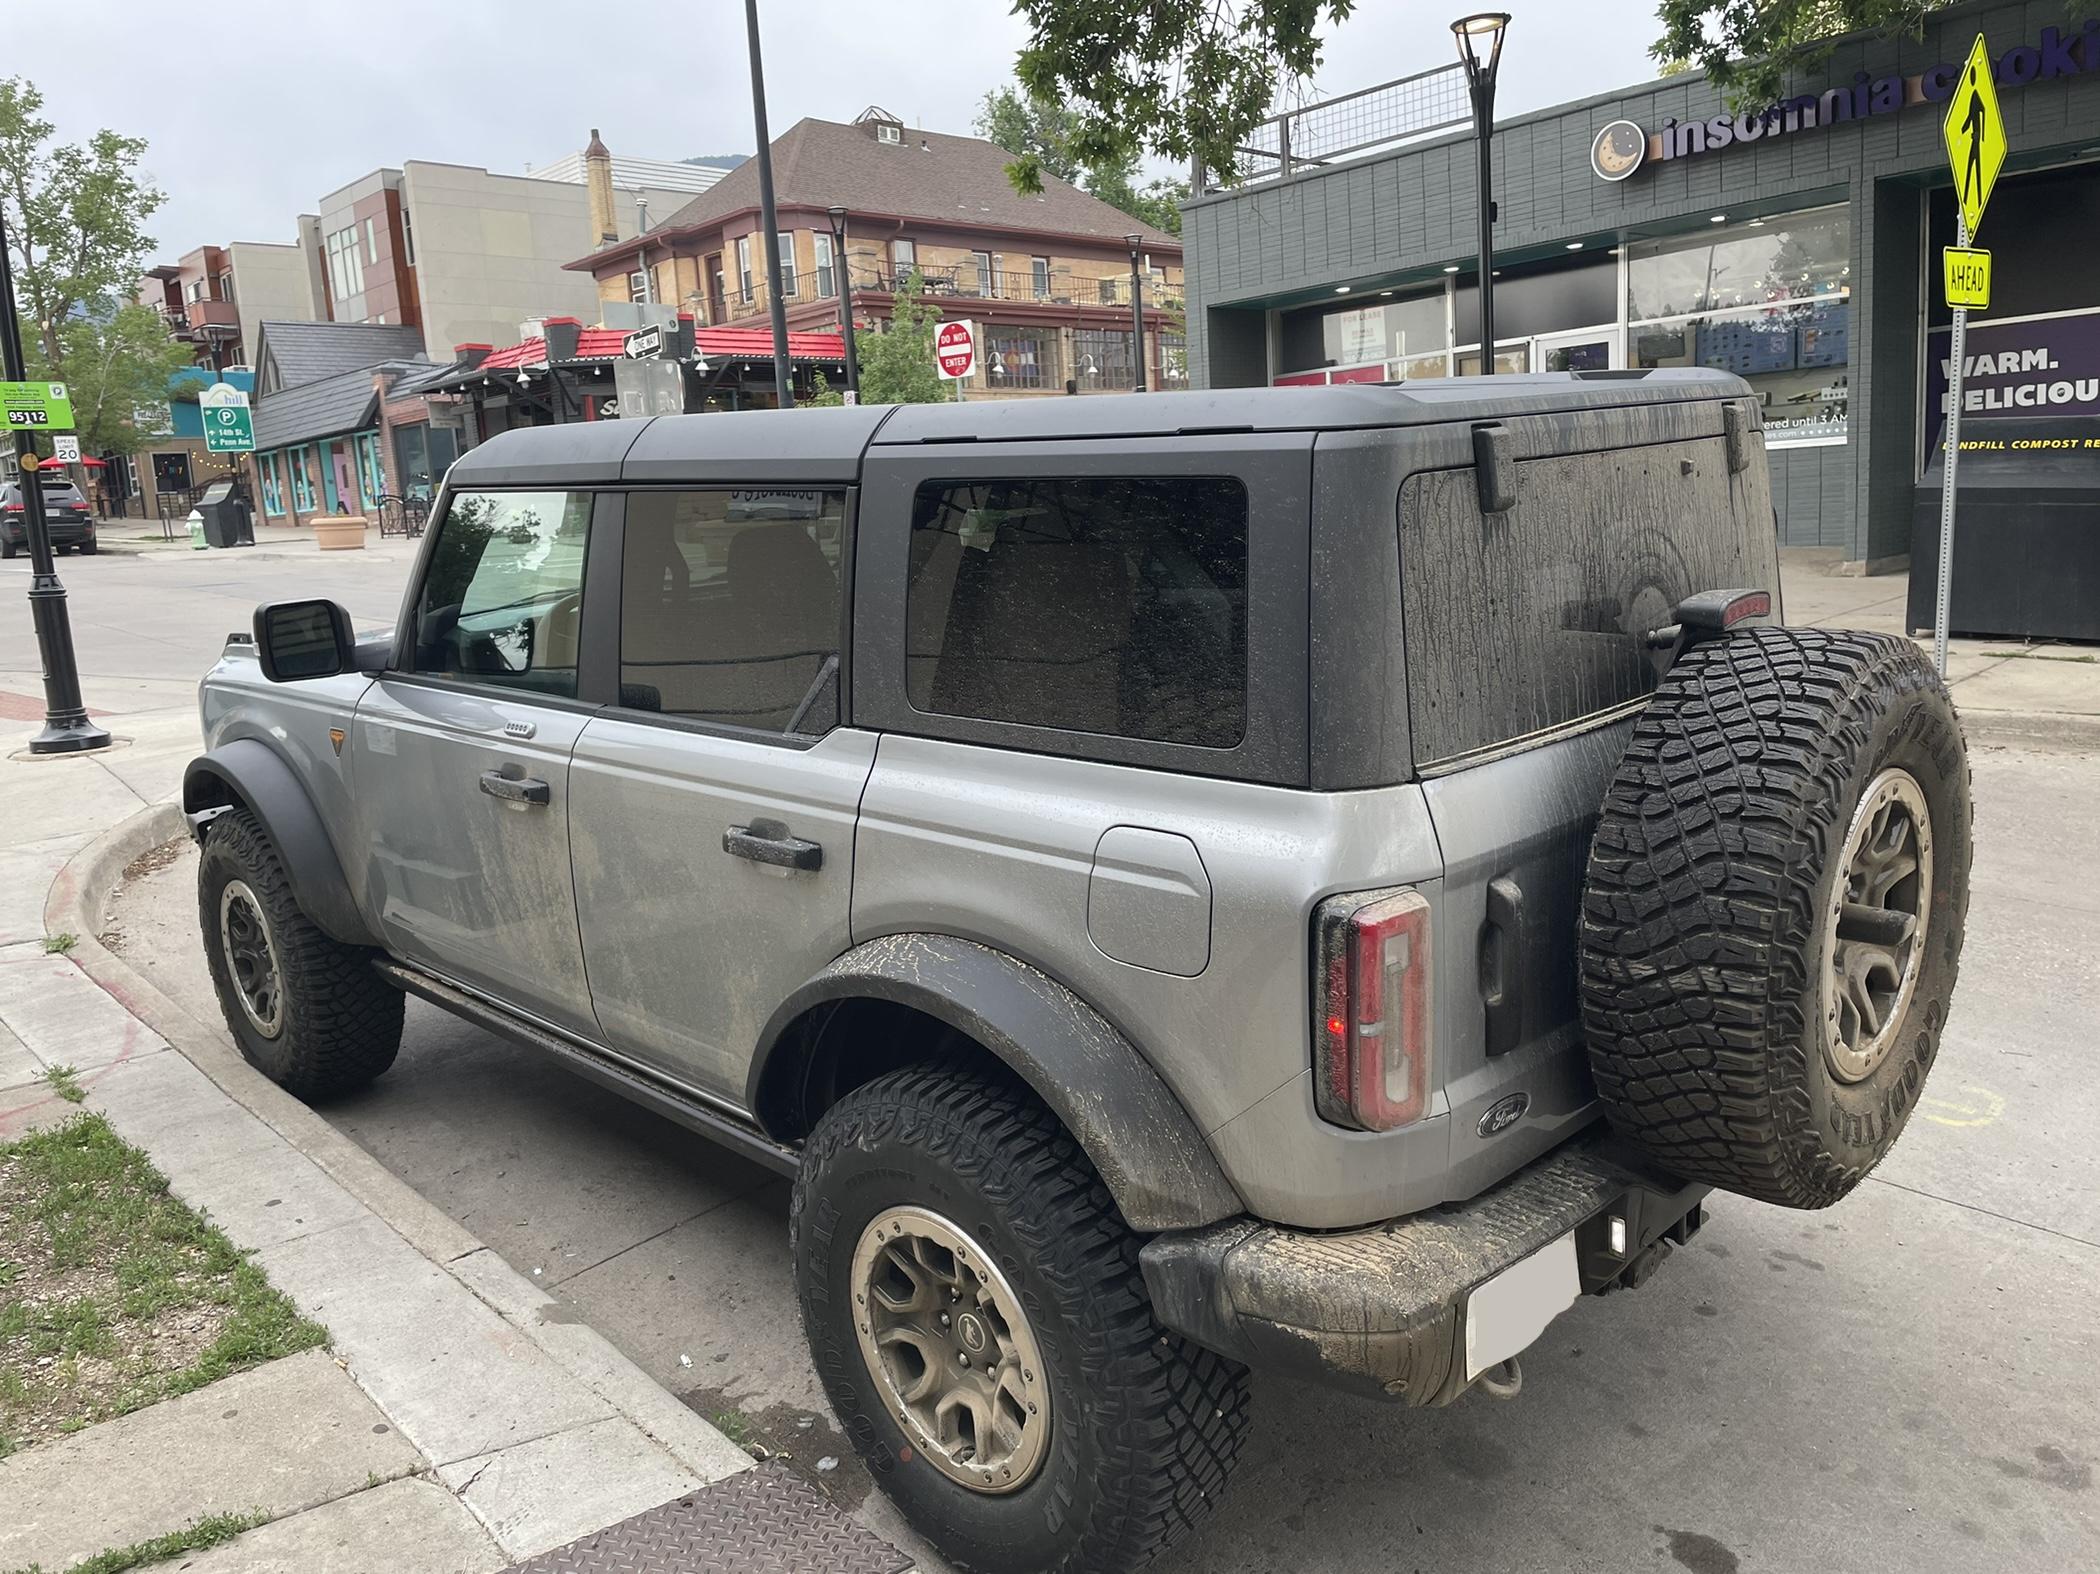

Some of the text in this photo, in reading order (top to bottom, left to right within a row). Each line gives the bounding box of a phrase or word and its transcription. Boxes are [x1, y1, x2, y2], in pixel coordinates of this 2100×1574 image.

[1662, 18, 2100, 161] insomnia coki
[1951, 264, 1984, 292] AHEAD
[633, 335, 657, 351] ONE WAY
[941, 331, 967, 344] DO NOT
[945, 356, 967, 368] ENTER
[1940, 347, 2059, 380] WARM.
[224, 394, 242, 405] hill
[8, 411, 47, 421] 95112
[221, 411, 231, 422] P
[1762, 418, 1789, 430] ered
[1792, 416, 1817, 427] until
[1820, 415, 1827, 425] 3
[219, 428, 234, 436] 14th
[220, 438, 237, 446] Penn
[1942, 440, 2006, 451] LNDFILL
[2011, 438, 2080, 450] COMPOST
[58, 450, 78, 460] 20
